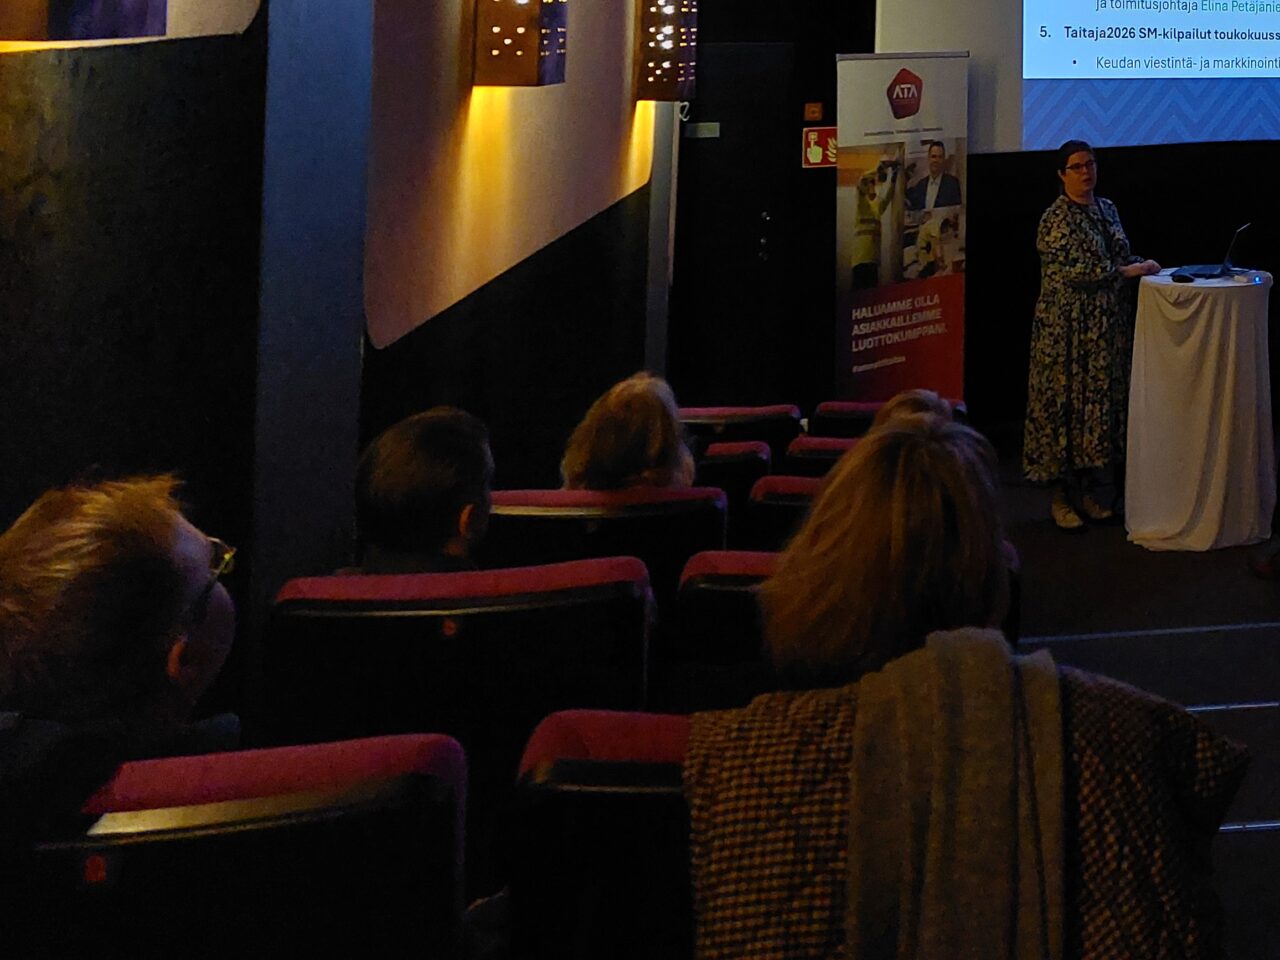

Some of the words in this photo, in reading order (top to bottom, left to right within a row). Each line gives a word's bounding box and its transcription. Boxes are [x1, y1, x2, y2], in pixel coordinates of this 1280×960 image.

[1201, 0, 1228, 11] Elina
[1039, 25, 1052, 38] 5.
[1064, 25, 1136, 42] Taitaja2026
[1138, 27, 1212, 42] SM-kilpailut
[1096, 56, 1141, 69] Keudan
[1143, 56, 1197, 69] viestintä-
[1199, 56, 1210, 71] ja
[893, 83, 918, 99] ATA
[852, 297, 913, 320] HALUAMME
[914, 293, 940, 309] OLLA
[851, 308, 943, 336] ASIAKKAILLEMME
